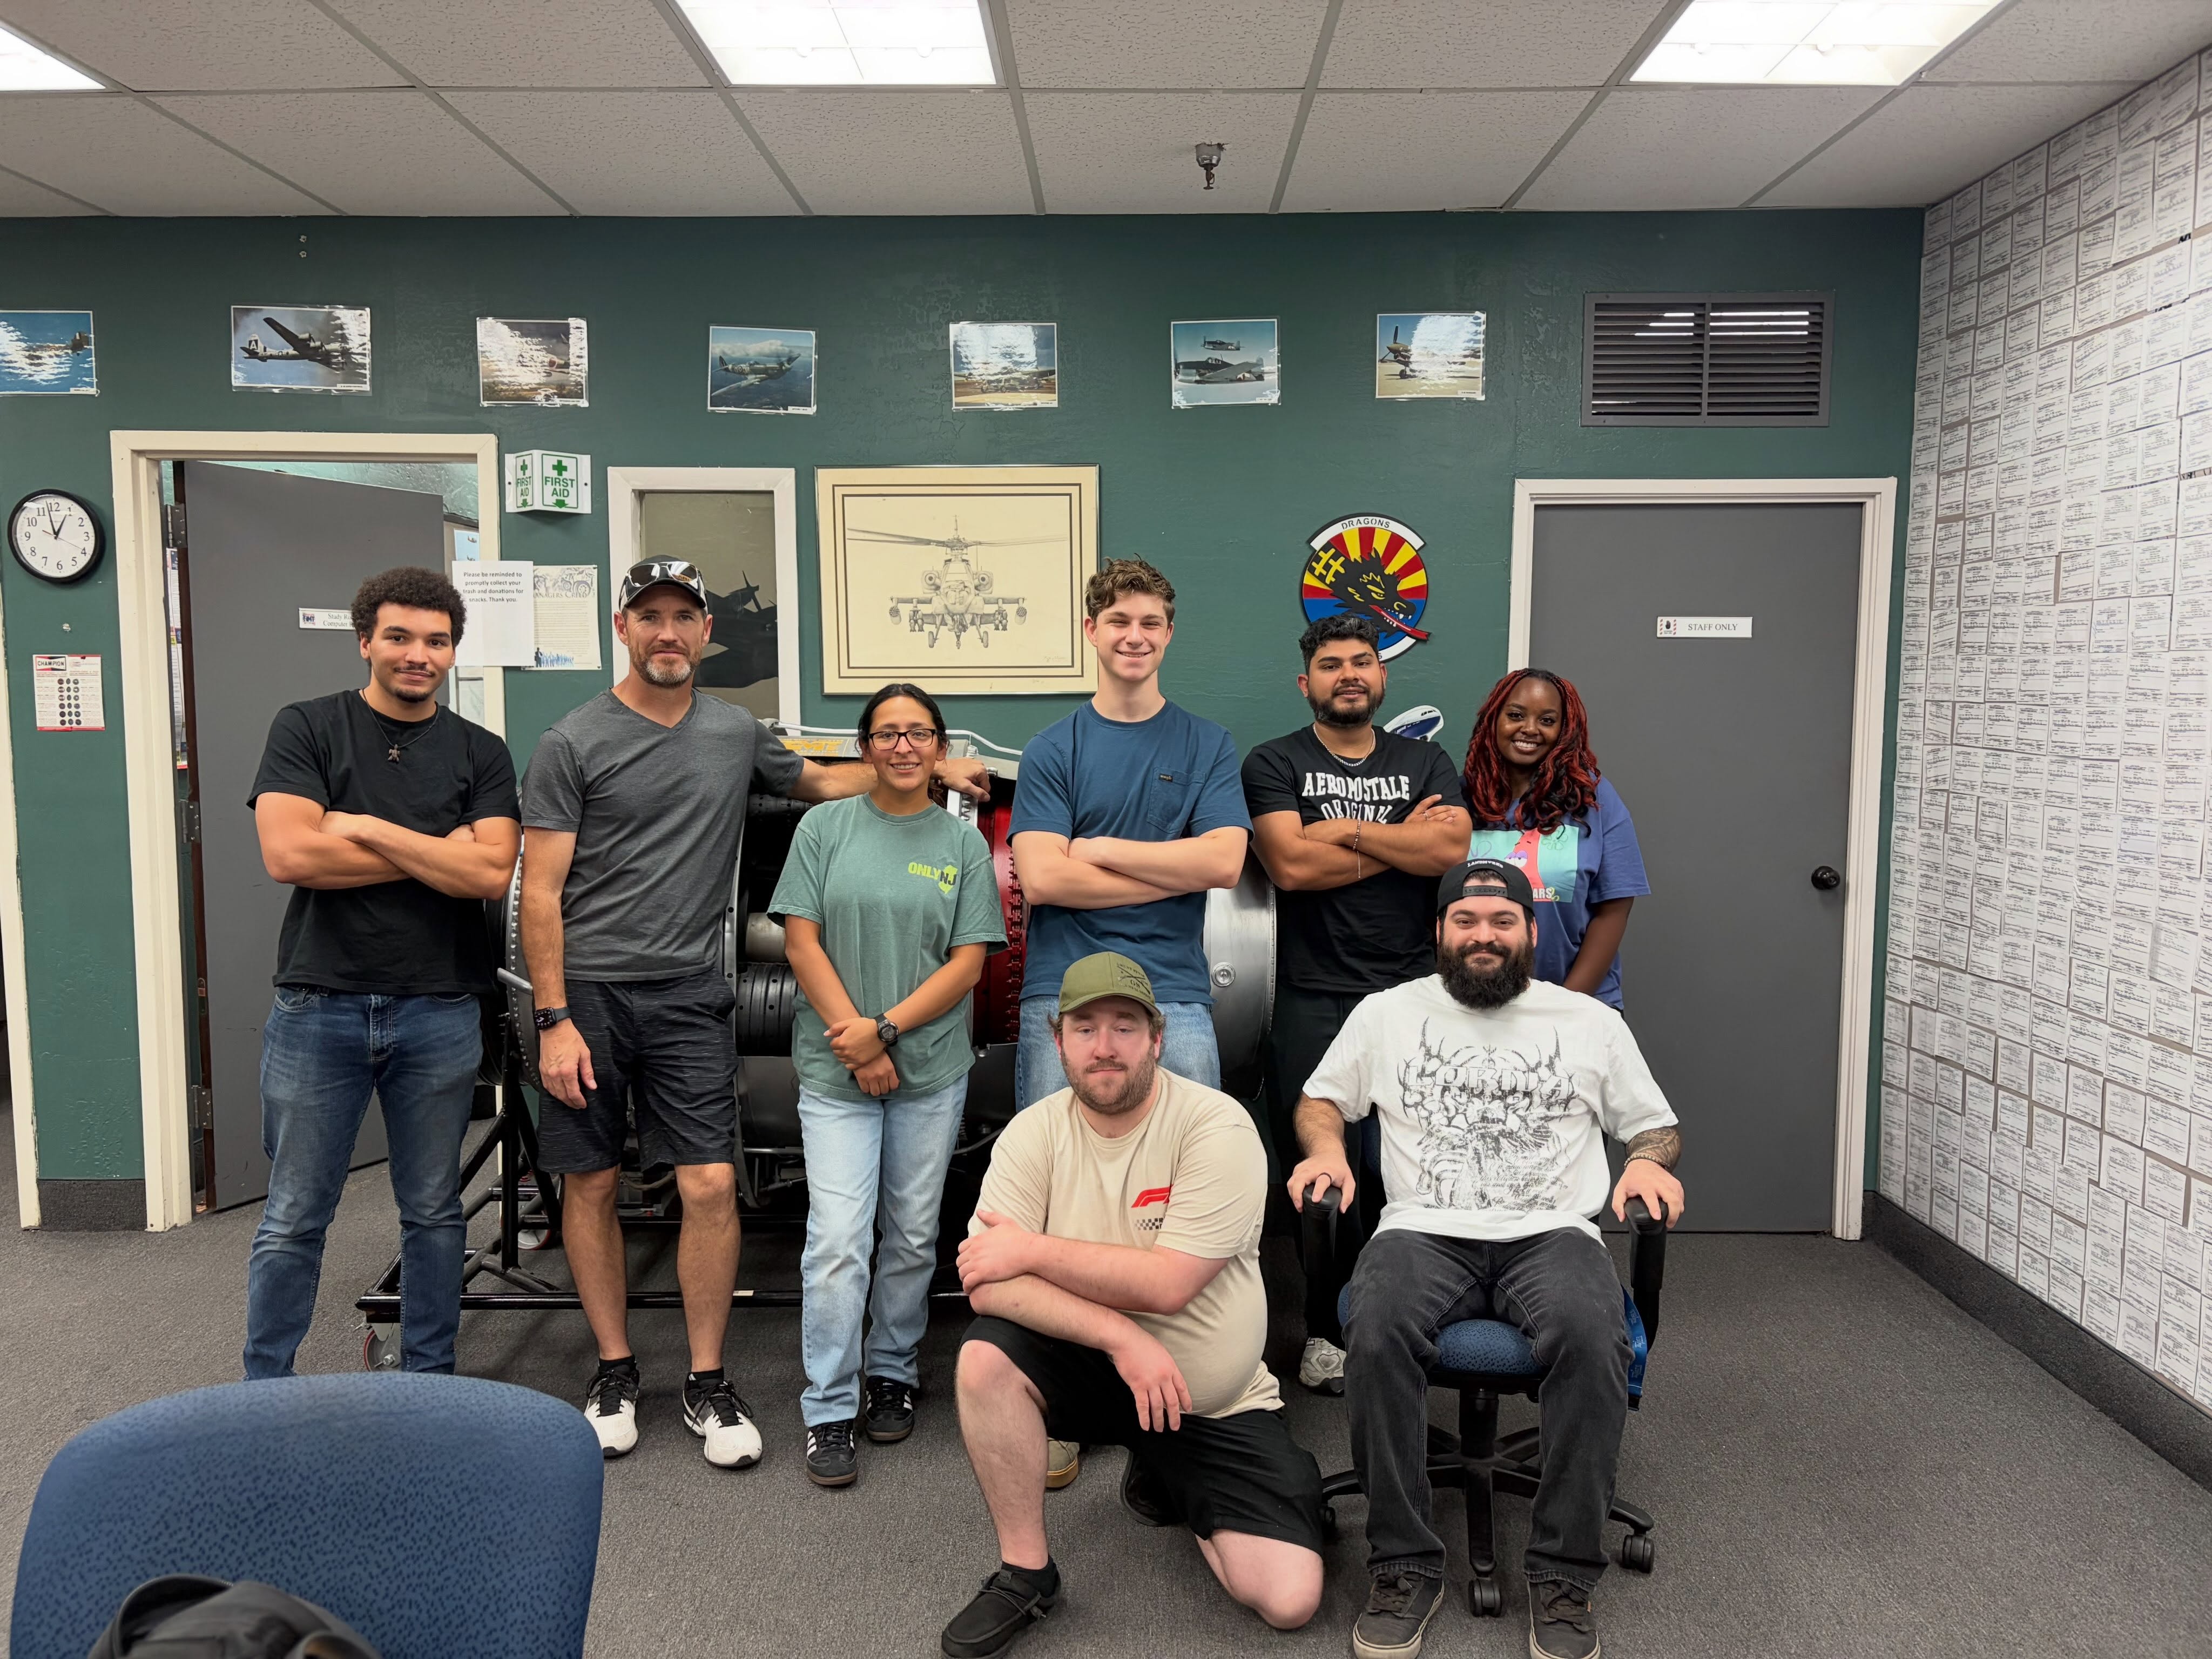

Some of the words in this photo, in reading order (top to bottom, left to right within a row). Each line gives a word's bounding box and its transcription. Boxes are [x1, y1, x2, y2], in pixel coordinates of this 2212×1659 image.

[249, 340, 257, 349] A
[517, 476, 531, 488] FIRST
[544, 476, 575, 488] FIRST
[520, 487, 529, 497] AID
[551, 488, 569, 497] AID
[37, 507, 46, 516] 11
[49, 502, 60, 512] 12
[68, 507, 72, 516] 1
[26, 517, 37, 527] 10
[78, 517, 85, 527] 2
[1341, 518, 1391, 530] DRAGONS
[25, 531, 31, 541] 9
[84, 532, 90, 541] 3
[30, 547, 36, 556] 8
[81, 547, 87, 556] 4
[42, 557, 48, 566] 7
[57, 561, 63, 570] 6
[71, 557, 77, 566] 5
[908, 862, 941, 880] ONLY
[940, 871, 957, 886] NJ
[1407, 1065, 1570, 1100] LORNA
